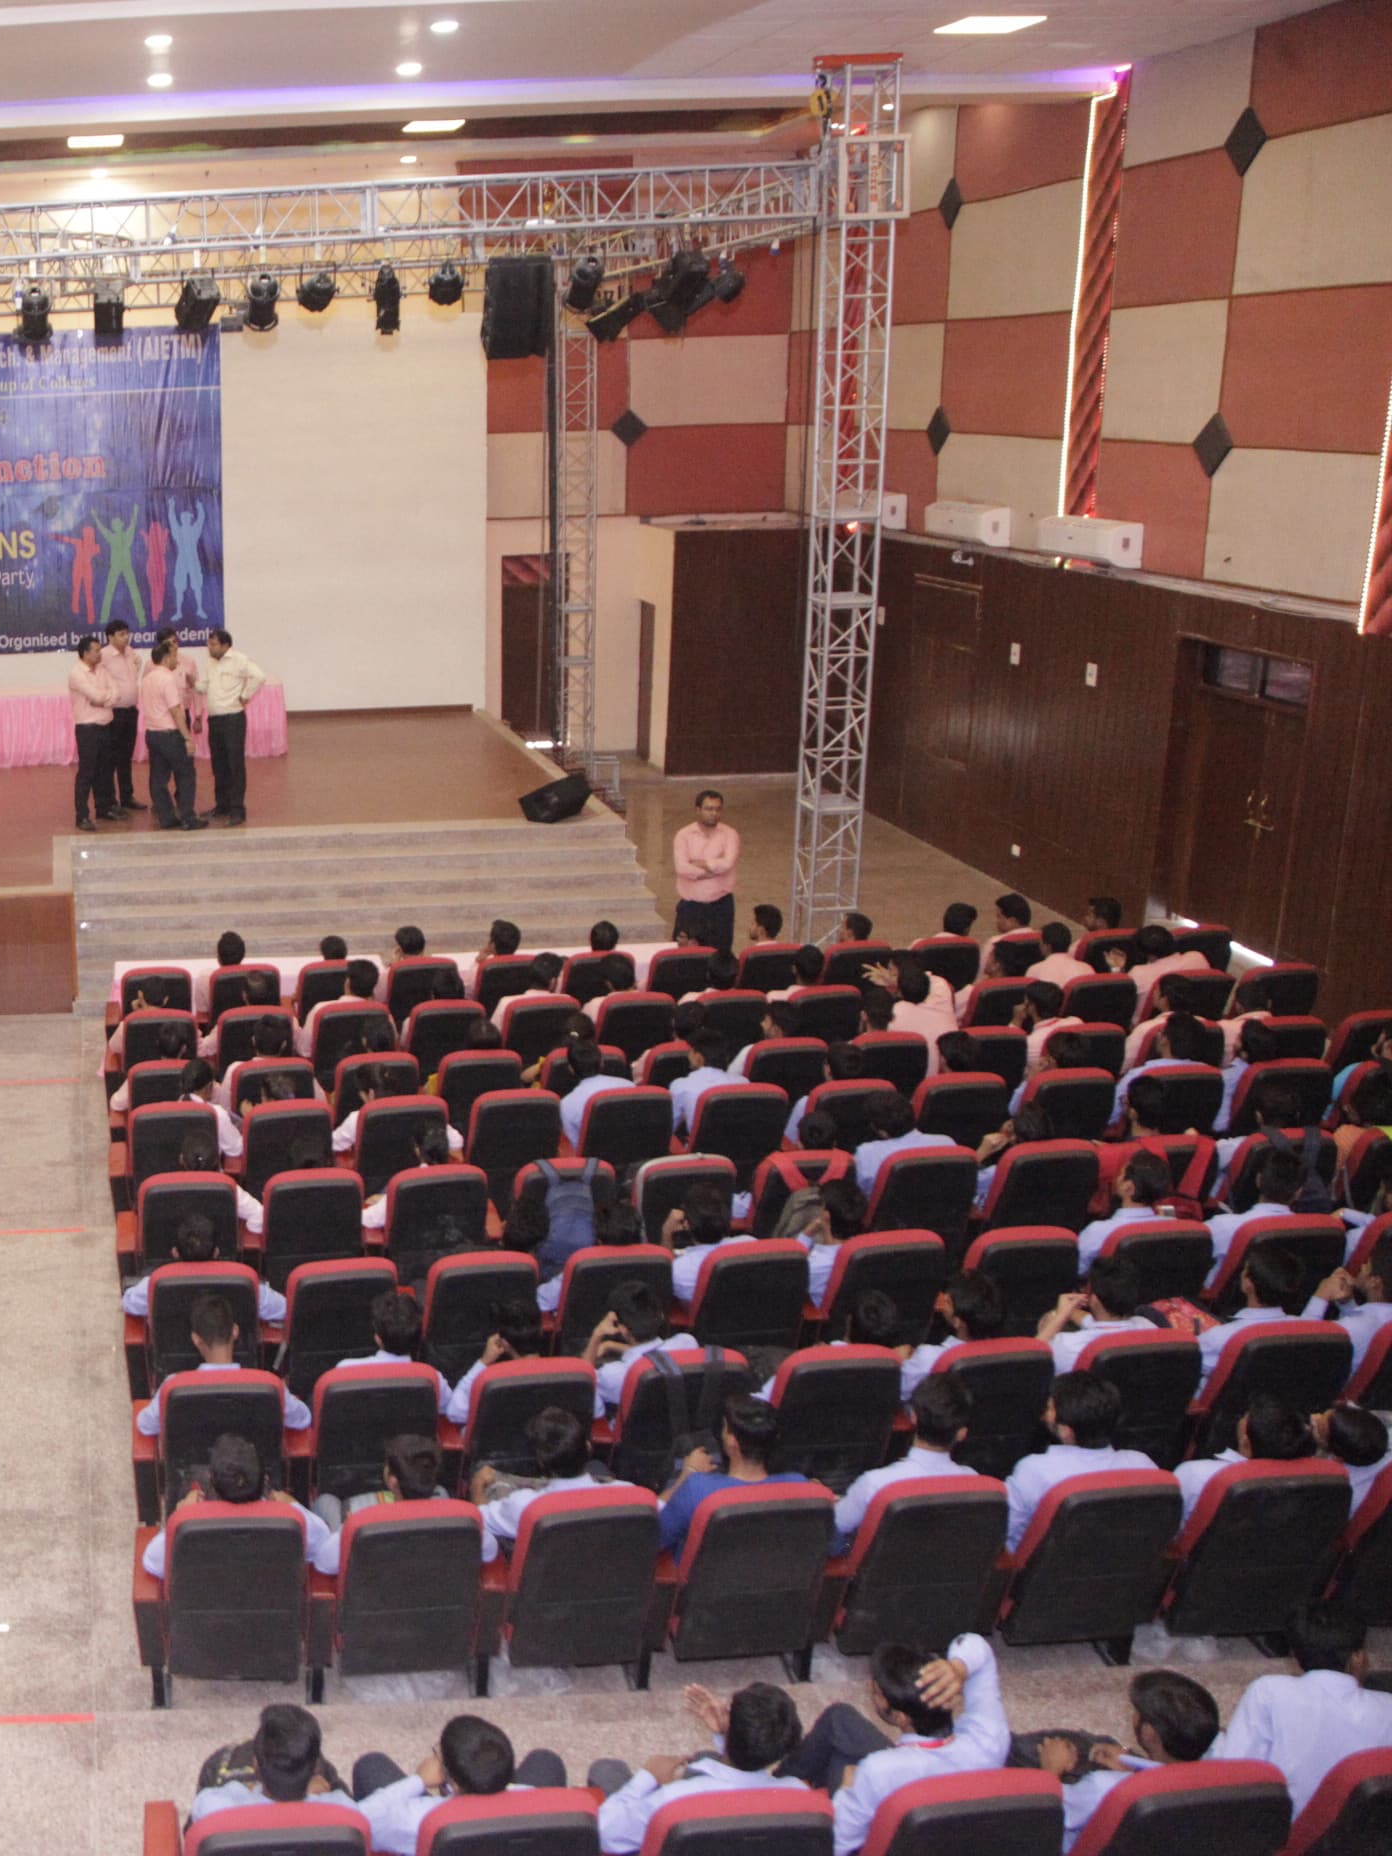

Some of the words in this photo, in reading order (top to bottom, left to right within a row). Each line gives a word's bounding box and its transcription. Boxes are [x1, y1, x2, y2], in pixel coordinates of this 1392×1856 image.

[25, 345, 36, 366] &
[40, 342, 132, 369] Management
[137, 334, 204, 367] (AIETM)
[21, 376, 34, 391] of
